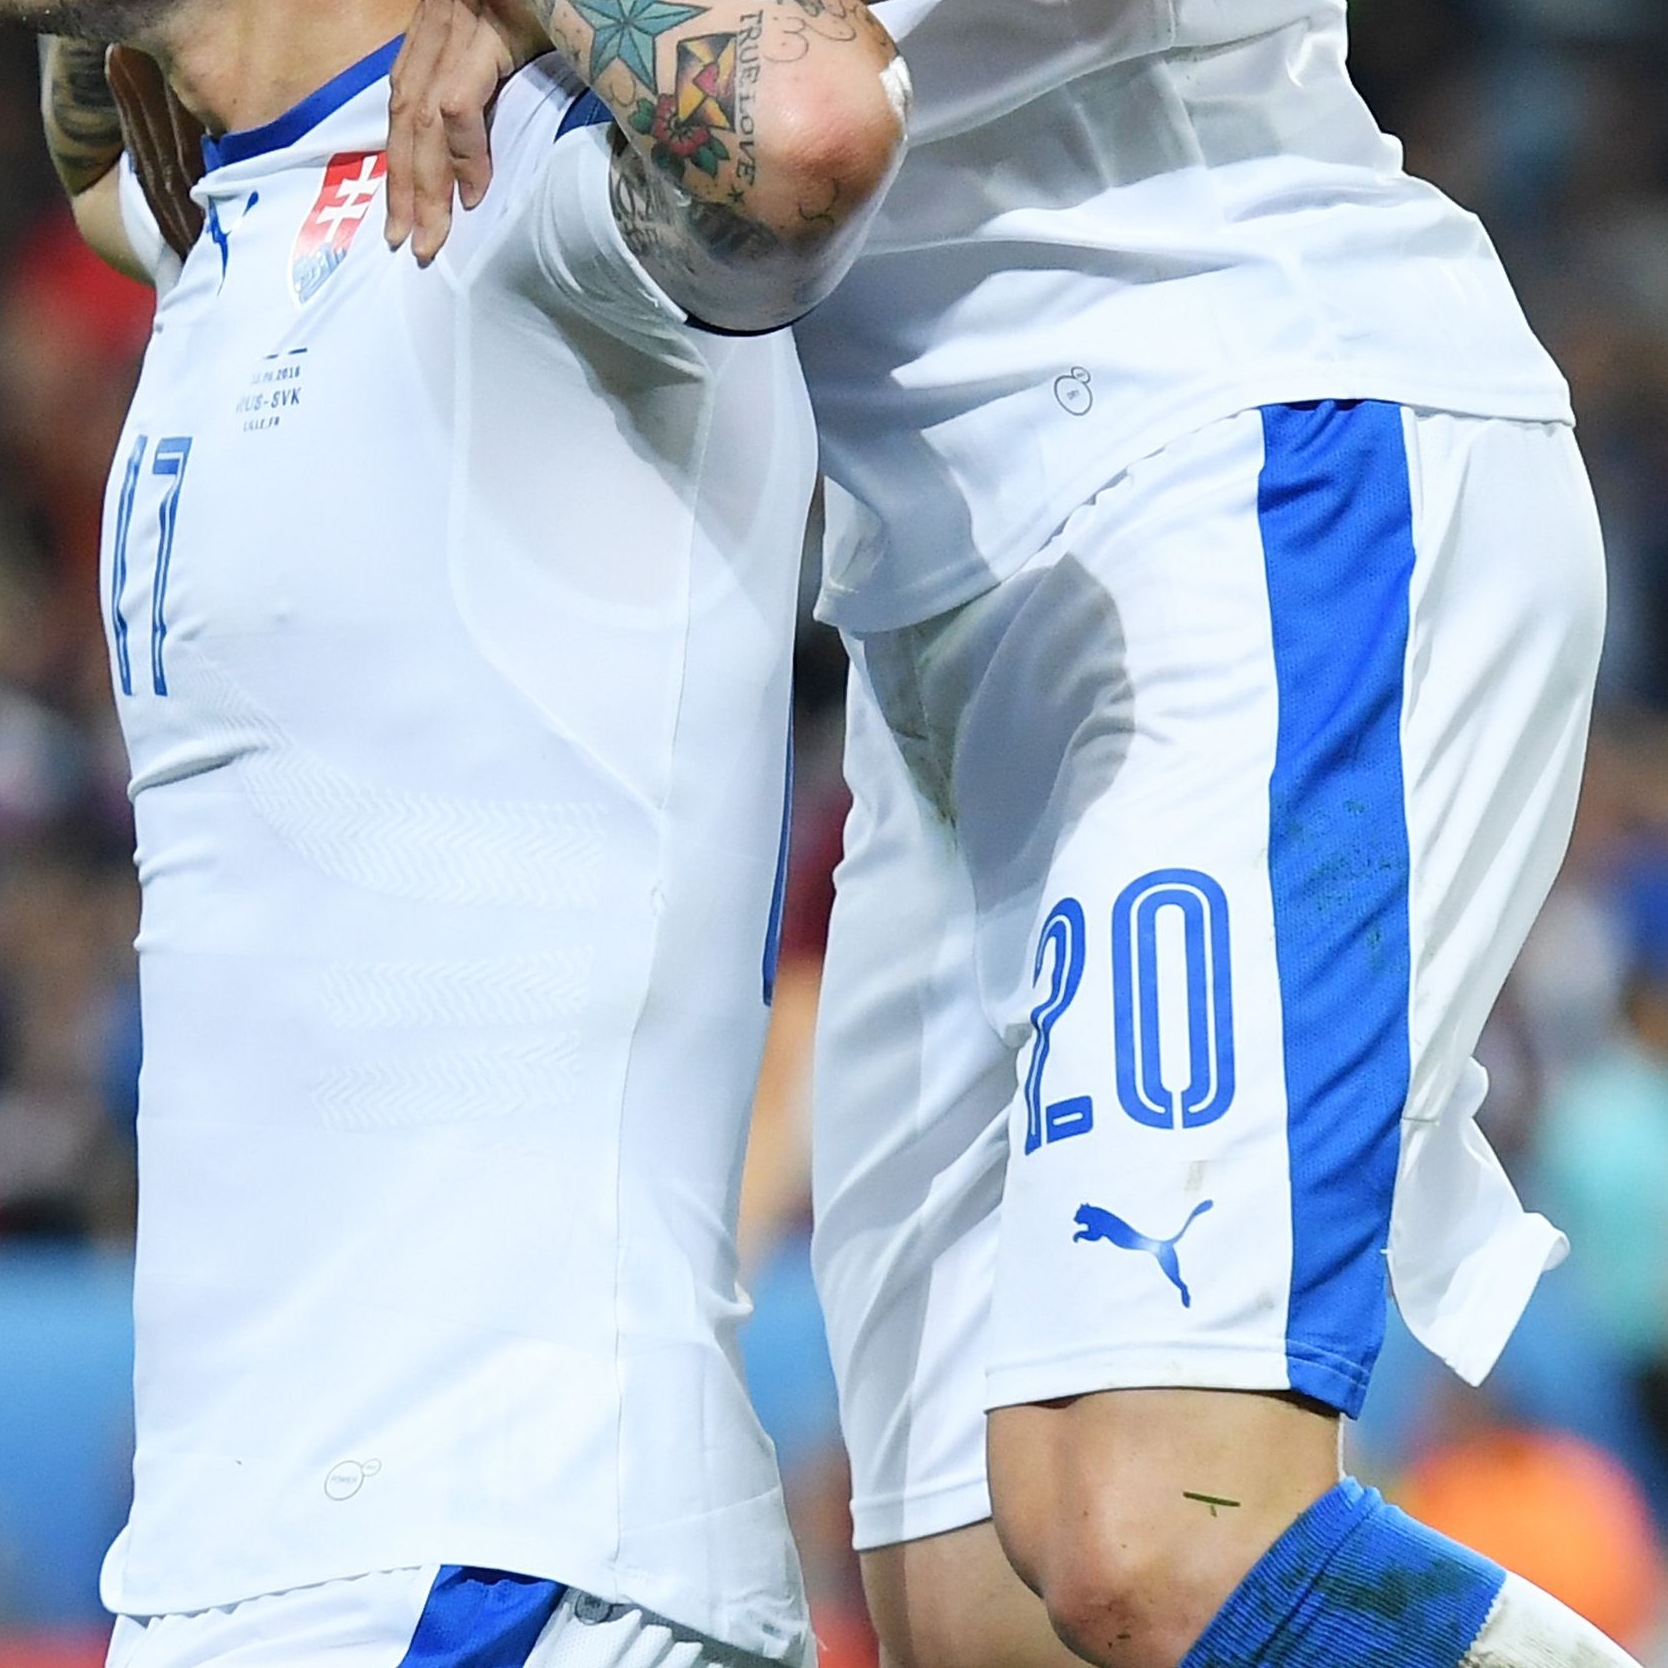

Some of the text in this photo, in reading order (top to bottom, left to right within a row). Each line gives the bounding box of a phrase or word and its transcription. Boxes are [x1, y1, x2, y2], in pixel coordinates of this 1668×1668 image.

[736, 9, 764, 186] TRUE LOVE
[112, 434, 193, 696] 17
[1025, 868, 1234, 1156] 20
